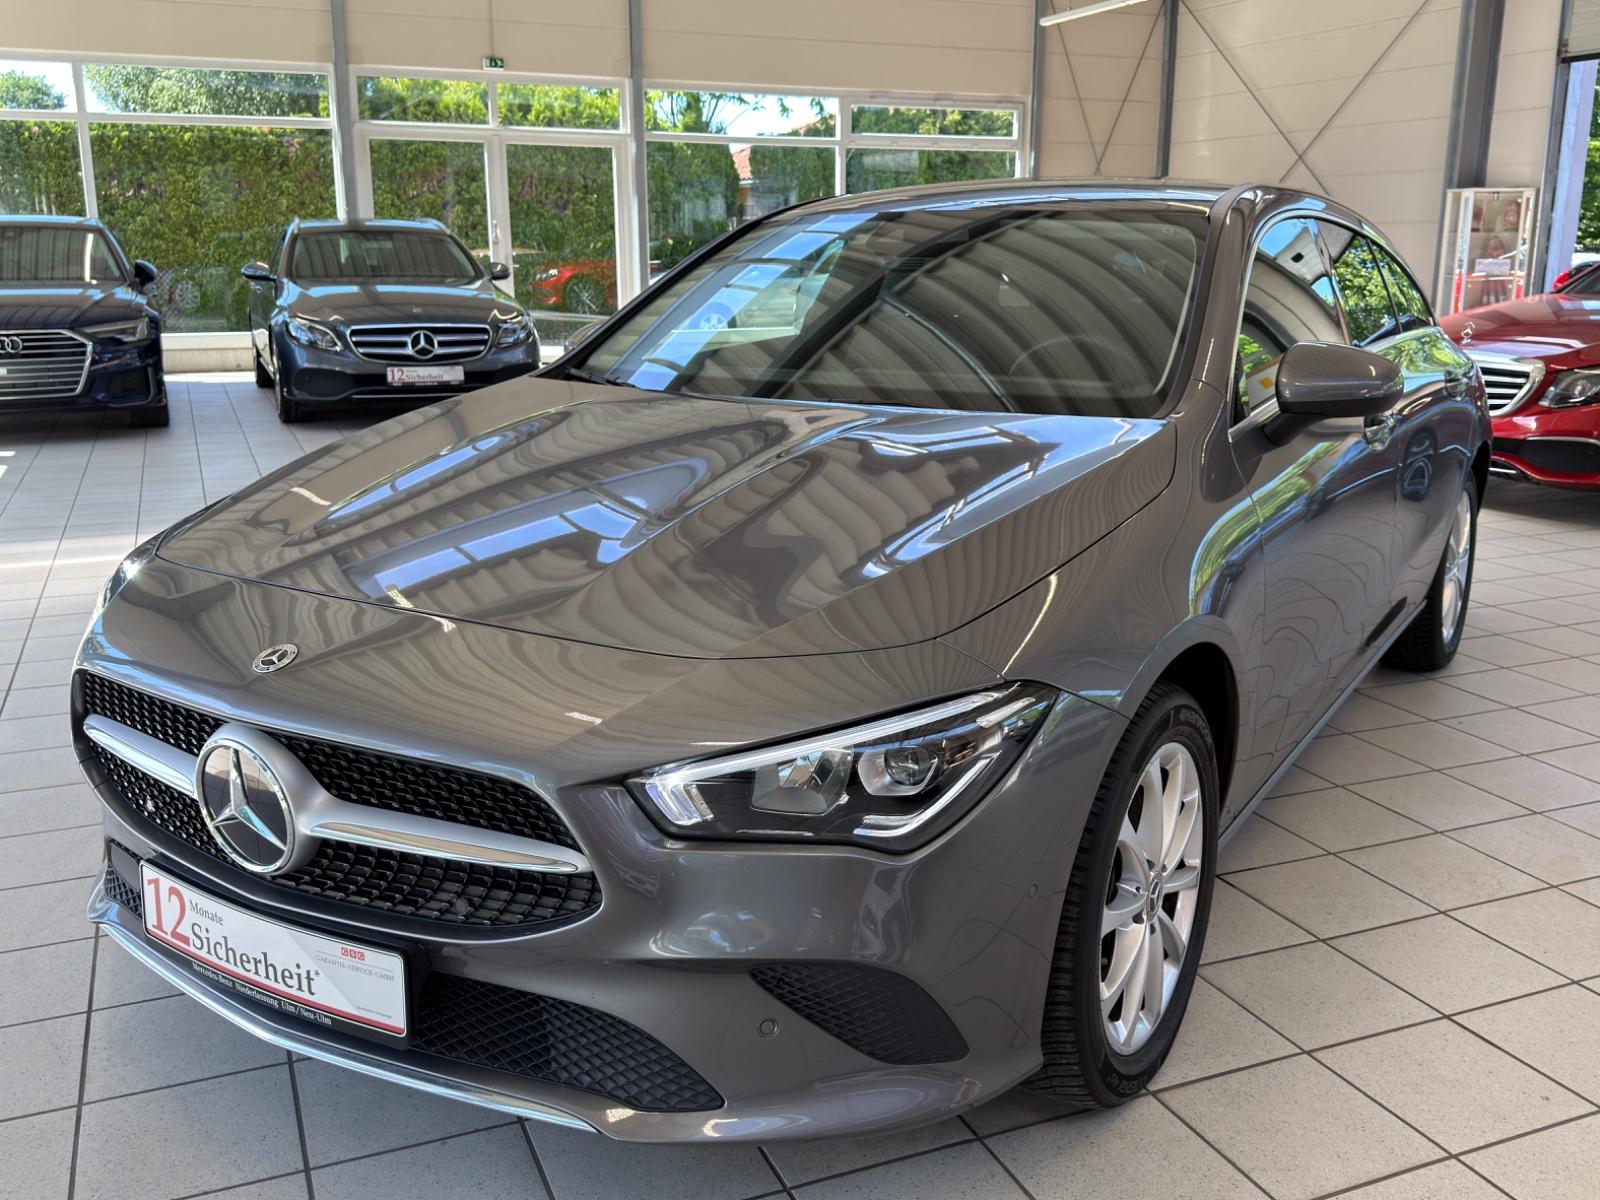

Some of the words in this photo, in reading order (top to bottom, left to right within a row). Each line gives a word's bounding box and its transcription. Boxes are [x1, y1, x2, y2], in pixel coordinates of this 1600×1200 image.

[389, 368, 405, 381] 12
[146, 876, 191, 948] 12
[189, 899, 224, 926] Monate
[192, 961, 233, 989] Mercedes-Benz
[235, 983, 279, 1008] Niederlassung
[281, 1001, 296, 1014] Ulm
[300, 1007, 332, 1026] Neu-Ulm
